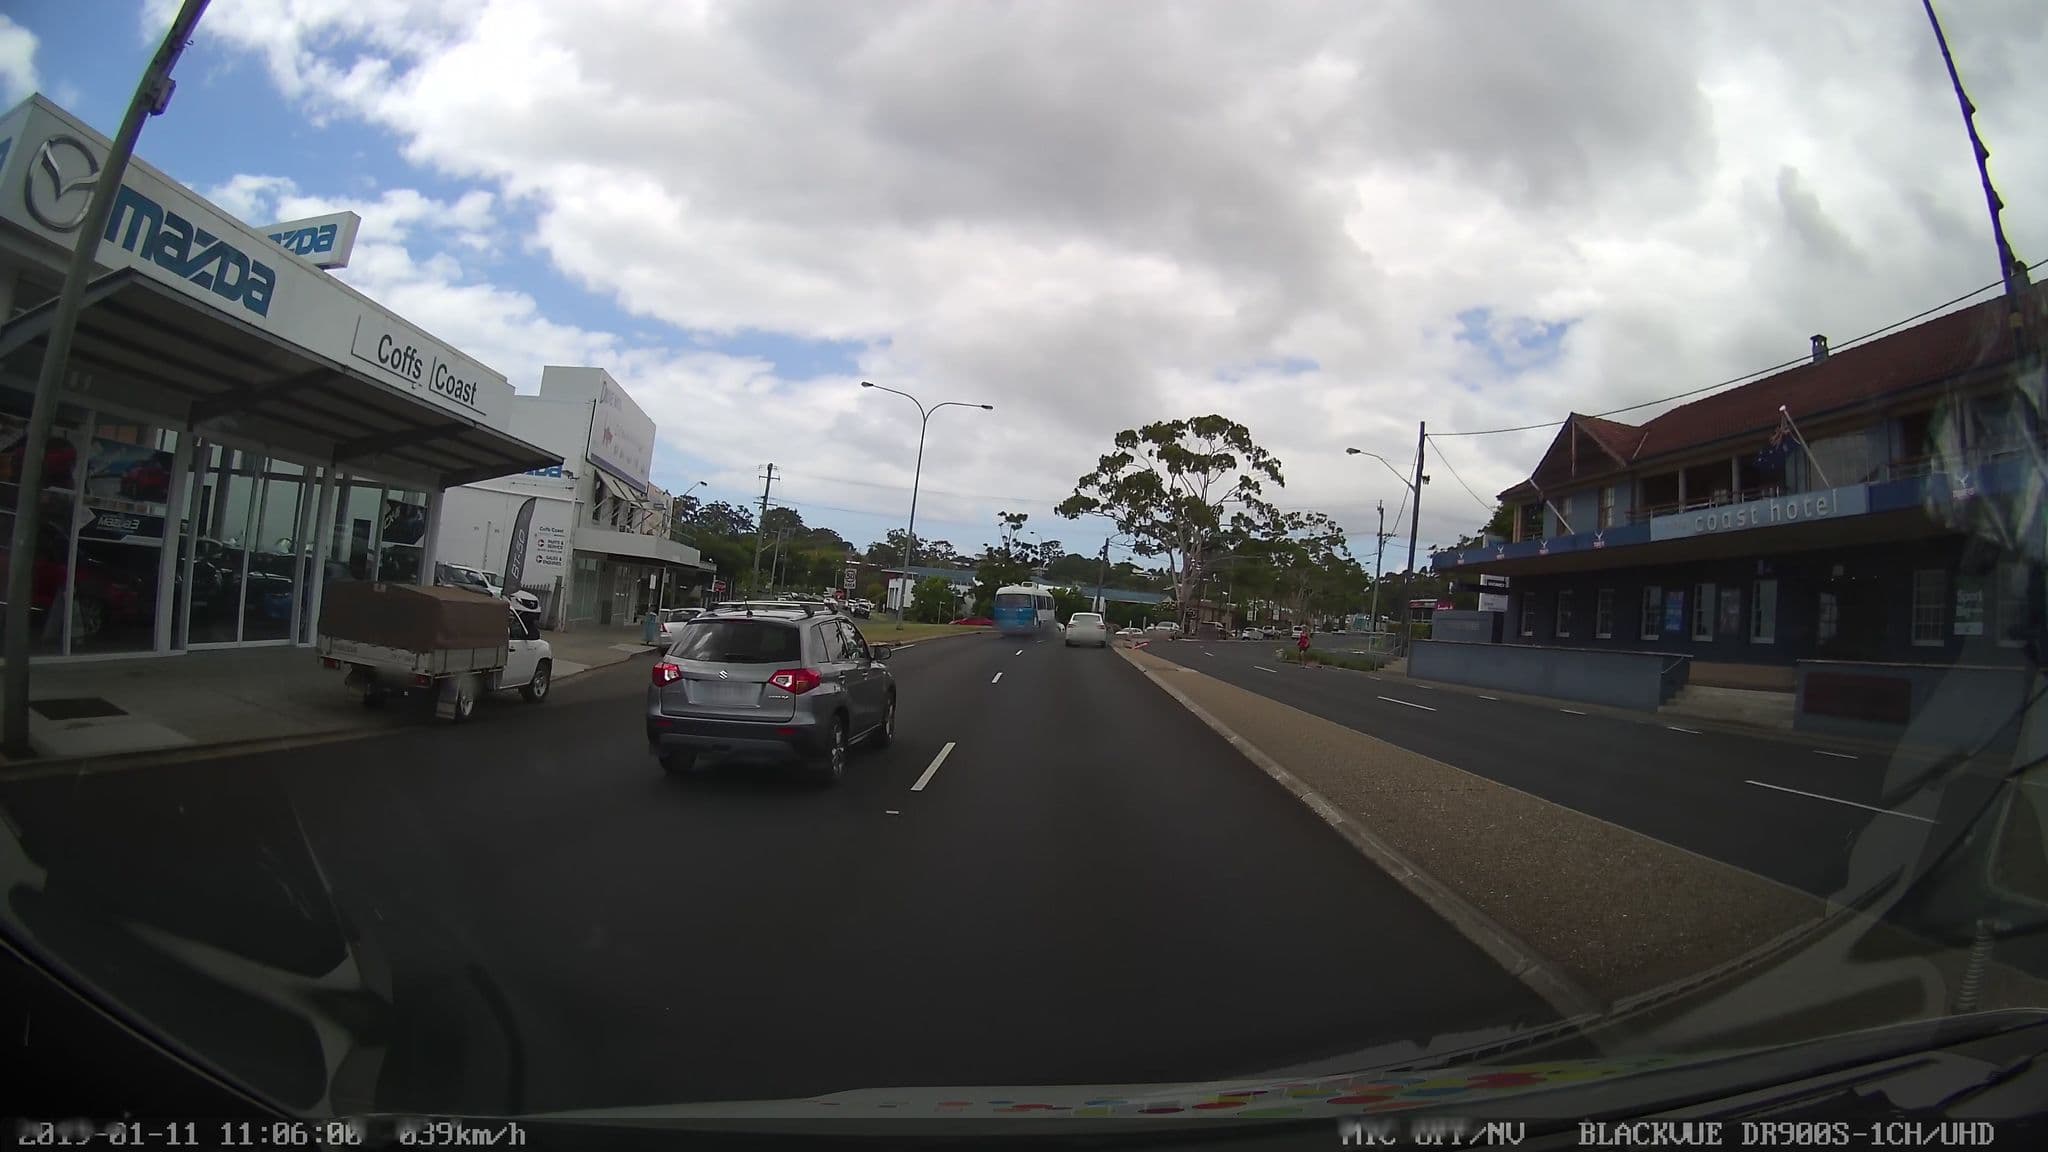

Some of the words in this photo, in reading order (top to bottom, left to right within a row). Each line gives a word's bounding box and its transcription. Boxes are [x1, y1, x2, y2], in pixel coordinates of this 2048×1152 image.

[104, 183, 276, 318] mazda
[378, 334, 423, 379] Coffs
[436, 363, 477, 405] Coast
[1694, 506, 1758, 532] coast
[1769, 488, 1838, 522] hotel
[512, 529, 526, 580] BT-50
